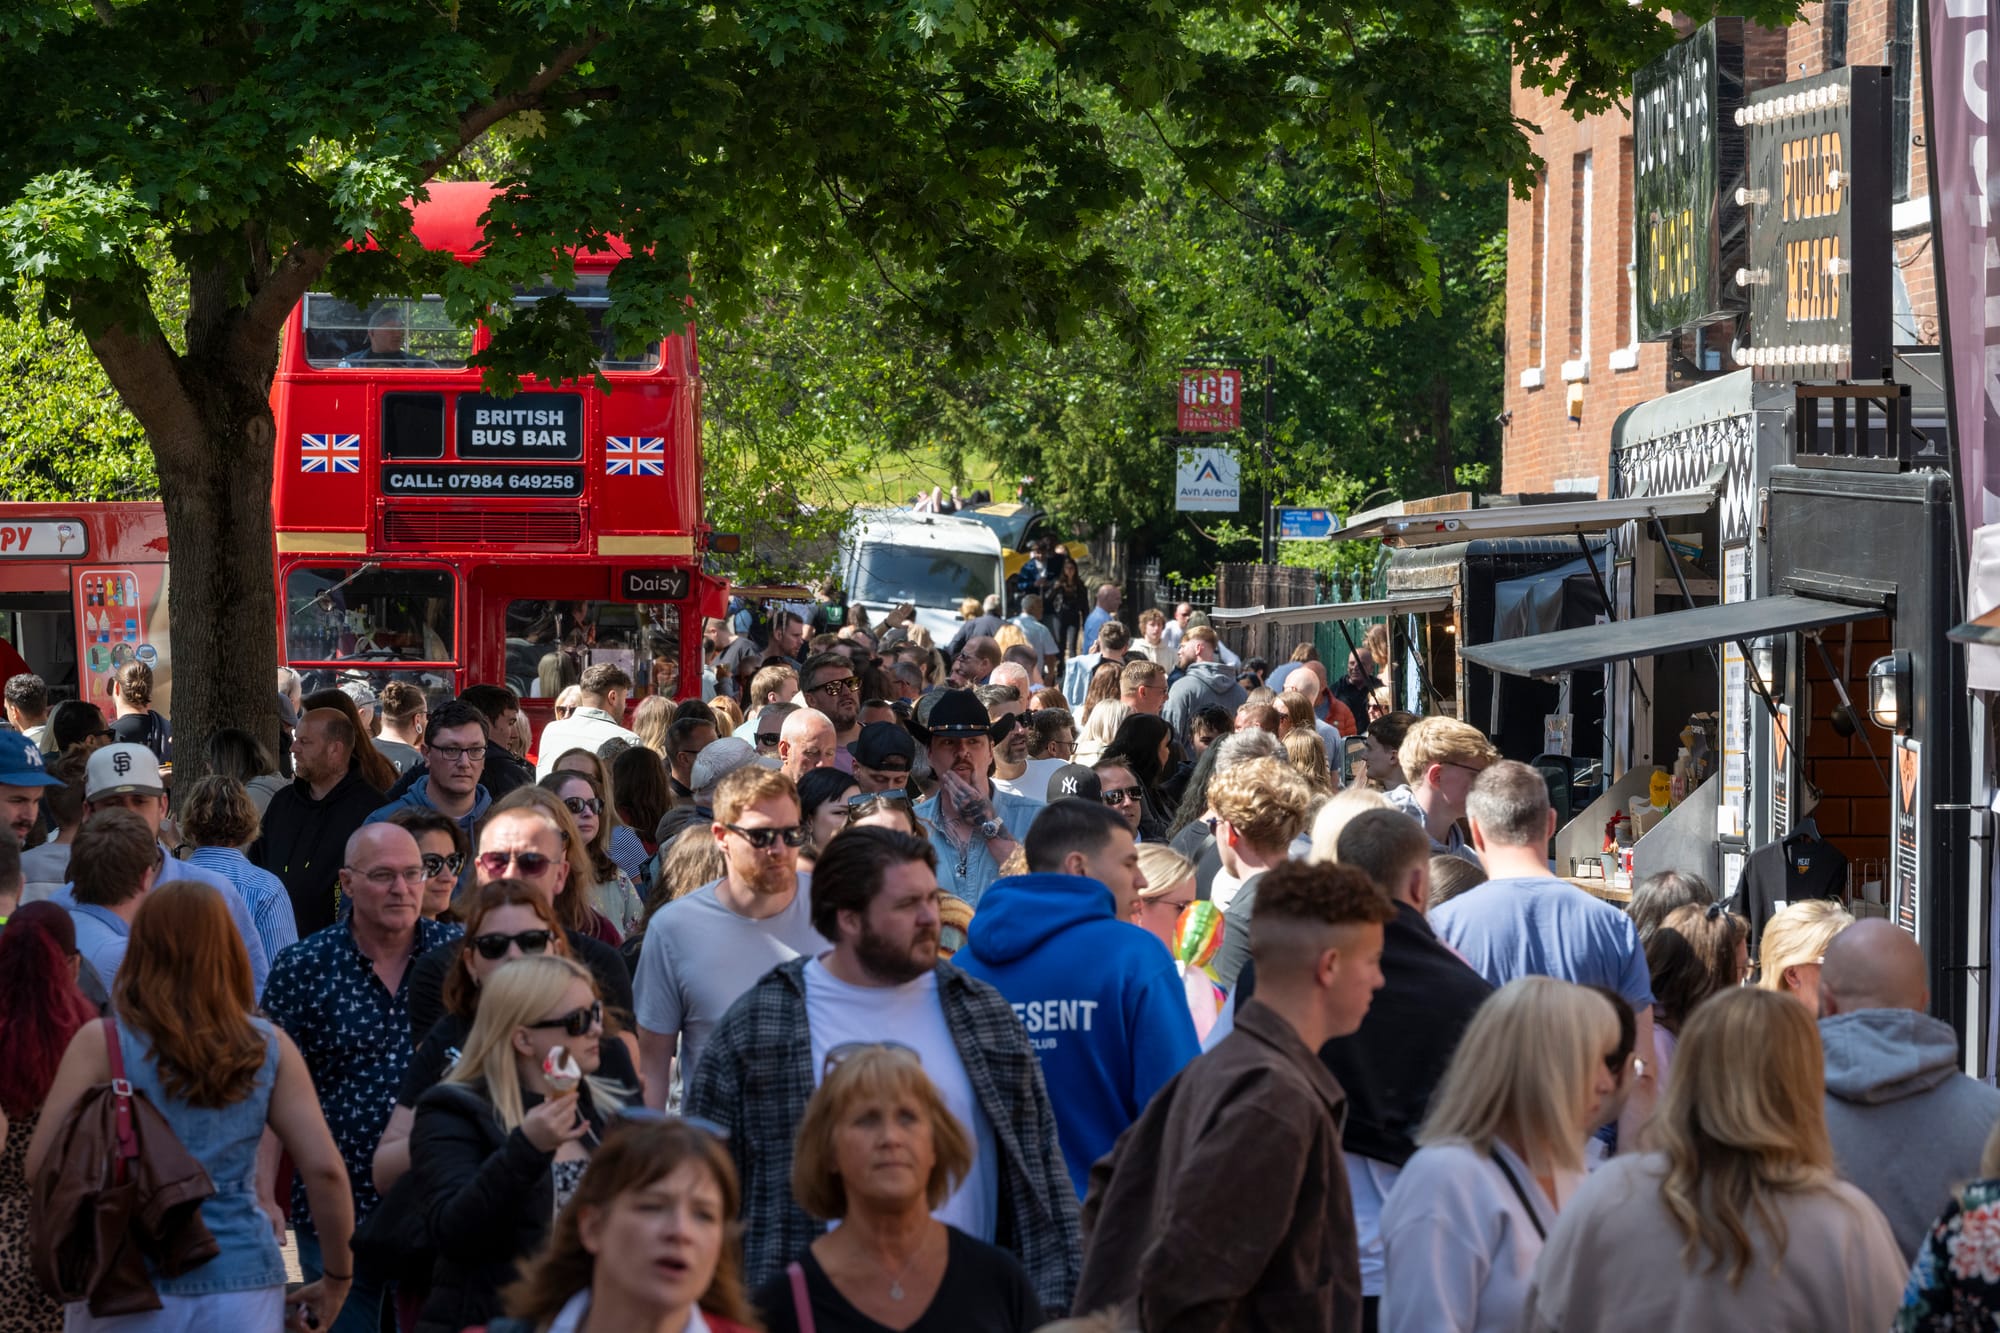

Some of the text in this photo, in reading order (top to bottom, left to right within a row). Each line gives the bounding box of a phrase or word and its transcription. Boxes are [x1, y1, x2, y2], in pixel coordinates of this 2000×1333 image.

[1782, 131, 1842, 222] PULLED
[1786, 235, 1839, 322] MEATS
[1184, 376, 1234, 405] HCB
[475, 409, 564, 426] BRITISH
[471, 429, 567, 446] BUS BAR
[390, 474, 575, 489] CALL: 07984 649258
[1180, 488, 1237, 497] Avn Arena
[630, 575, 681, 595] Daisy
[1061, 776, 1078, 794] NY
